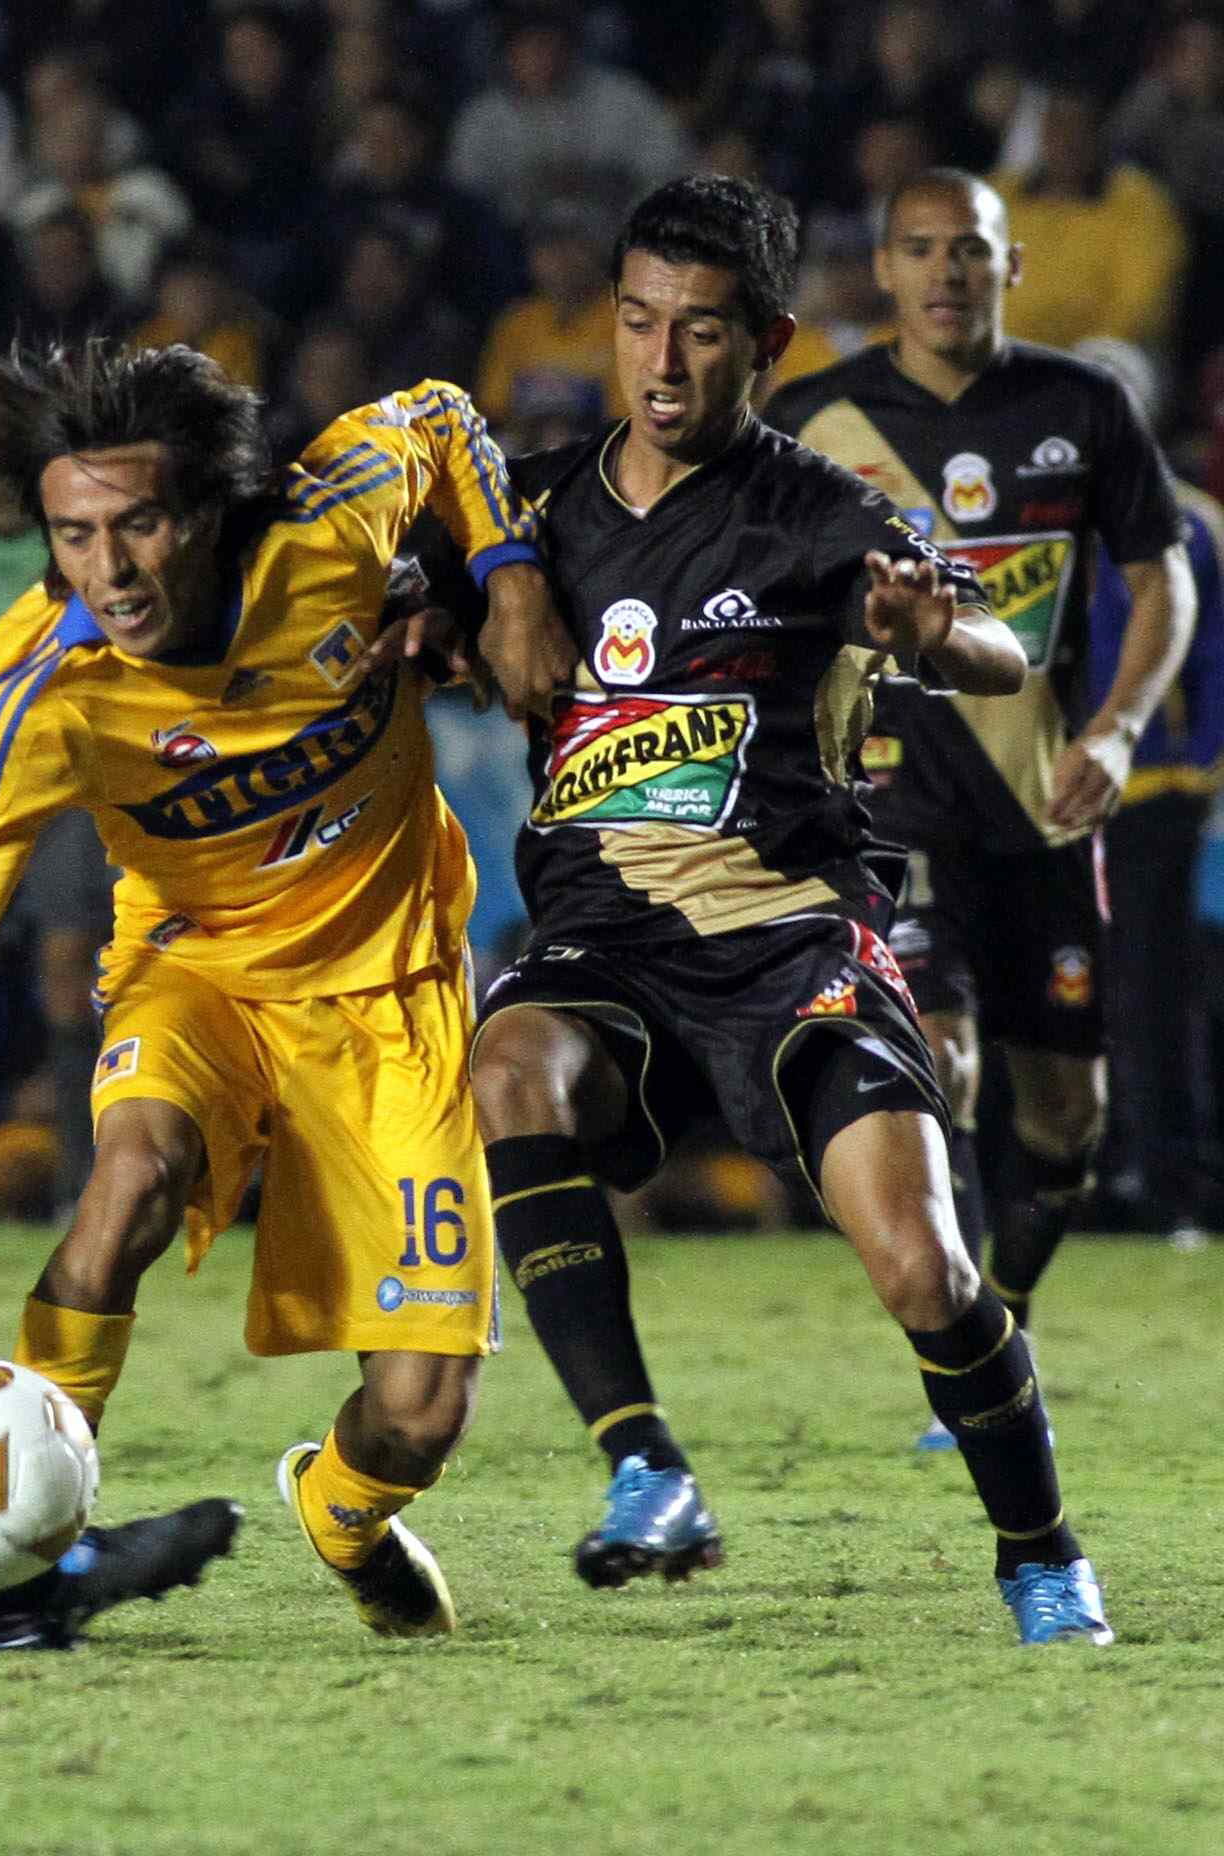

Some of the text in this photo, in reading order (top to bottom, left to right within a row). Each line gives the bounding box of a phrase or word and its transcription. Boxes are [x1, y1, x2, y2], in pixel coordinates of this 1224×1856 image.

[681, 616, 783, 631] BANCO AZTECA
[398, 1177, 468, 1267] 16
